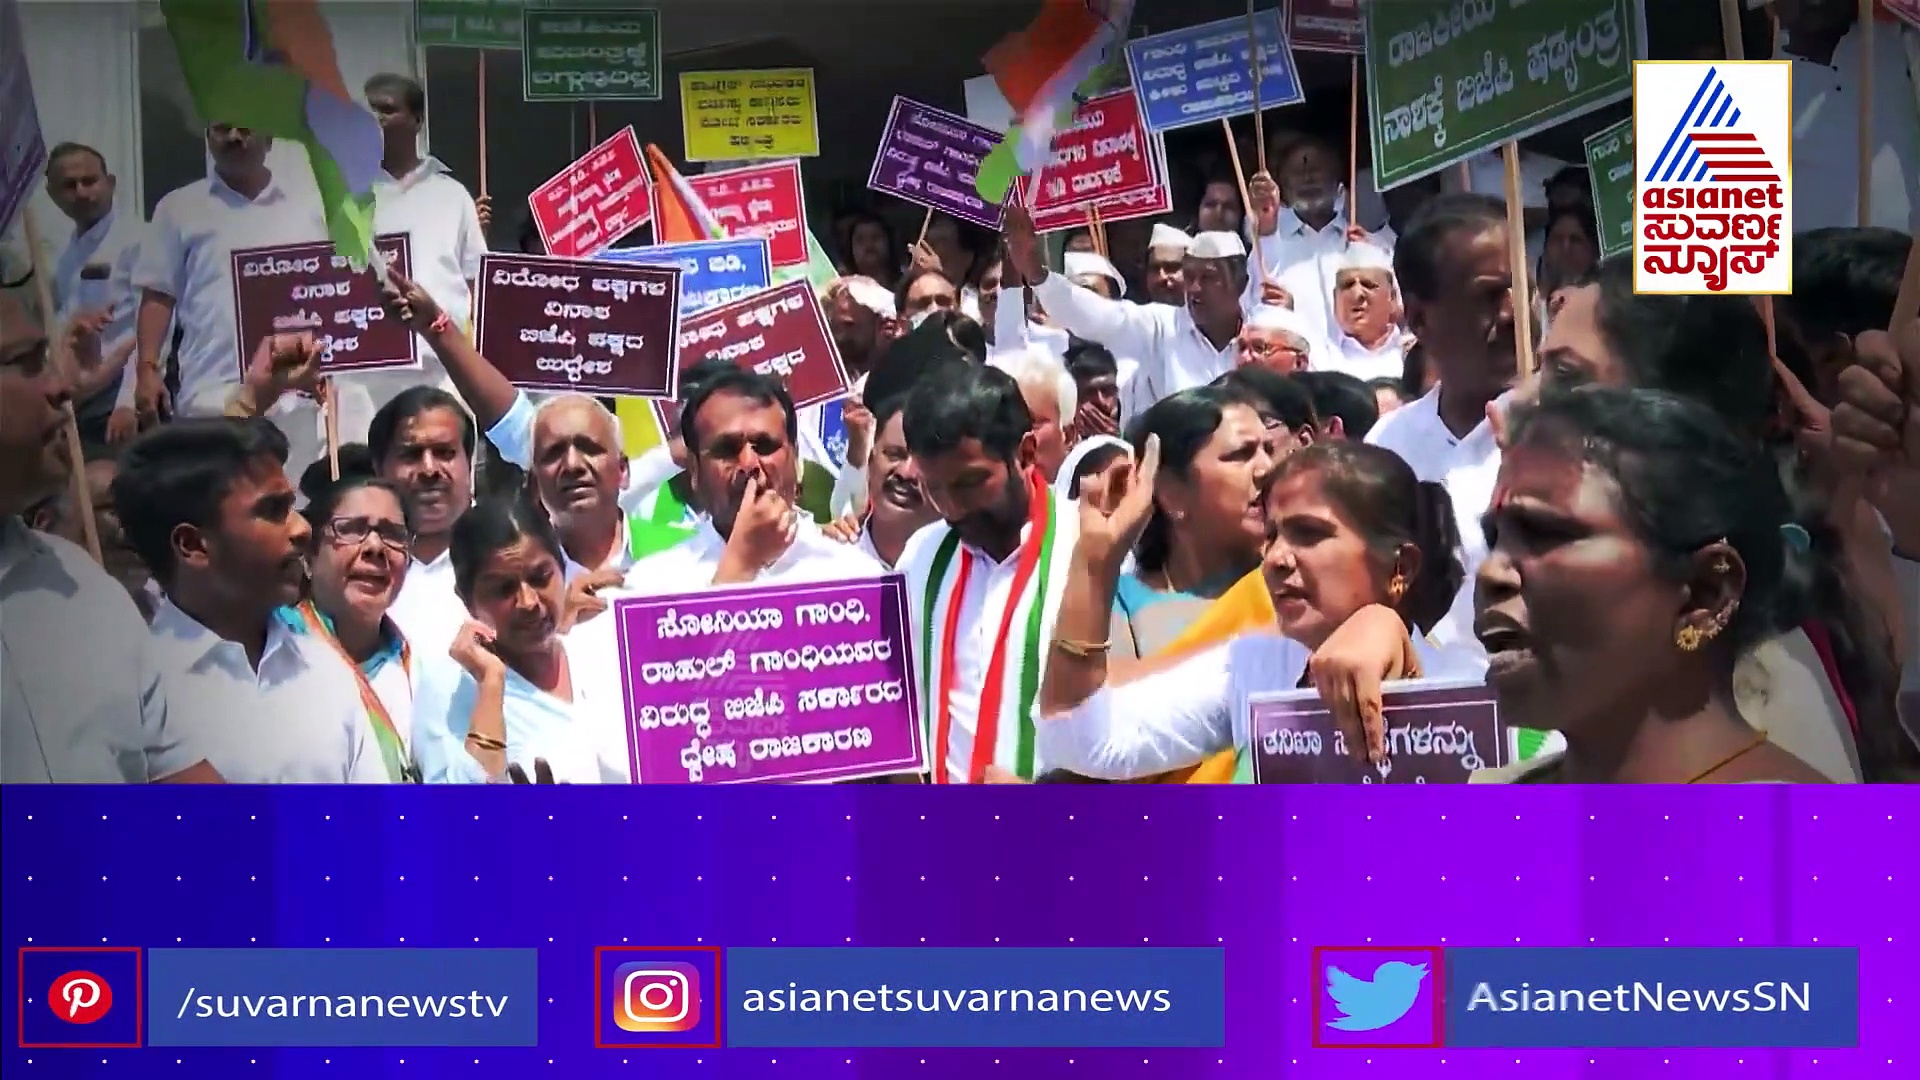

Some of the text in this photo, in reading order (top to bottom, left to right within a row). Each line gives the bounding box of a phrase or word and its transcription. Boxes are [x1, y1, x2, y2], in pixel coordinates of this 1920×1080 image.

[492, 267, 580, 293] ವಿರೋಧ
[592, 278, 667, 302] ಪಕ್ಷಗಳ
[544, 300, 611, 319] ವಿನಾಶ
[520, 323, 644, 357] ಬಿಜೆಪಿ ಪಕ್ಷದ
[536, 353, 613, 382] ಉದ್ದೇಶ
[656, 607, 784, 640] ಸೋನಿಯಾ
[641, 636, 892, 685] ರಾಹುಲ್ ಗಾಂಧಿಯವರ
[639, 698, 711, 739] ವಿರುದ್ಧ
[724, 687, 785, 721] ಬಿಜೆಪಿ
[798, 678, 903, 713] ಸರ್ಕಾರದ
[680, 725, 873, 783] ದ್ವೇಷ ರಾಜಕಾರಣ
[1263, 730, 1323, 756] ತನಿಖಾ
